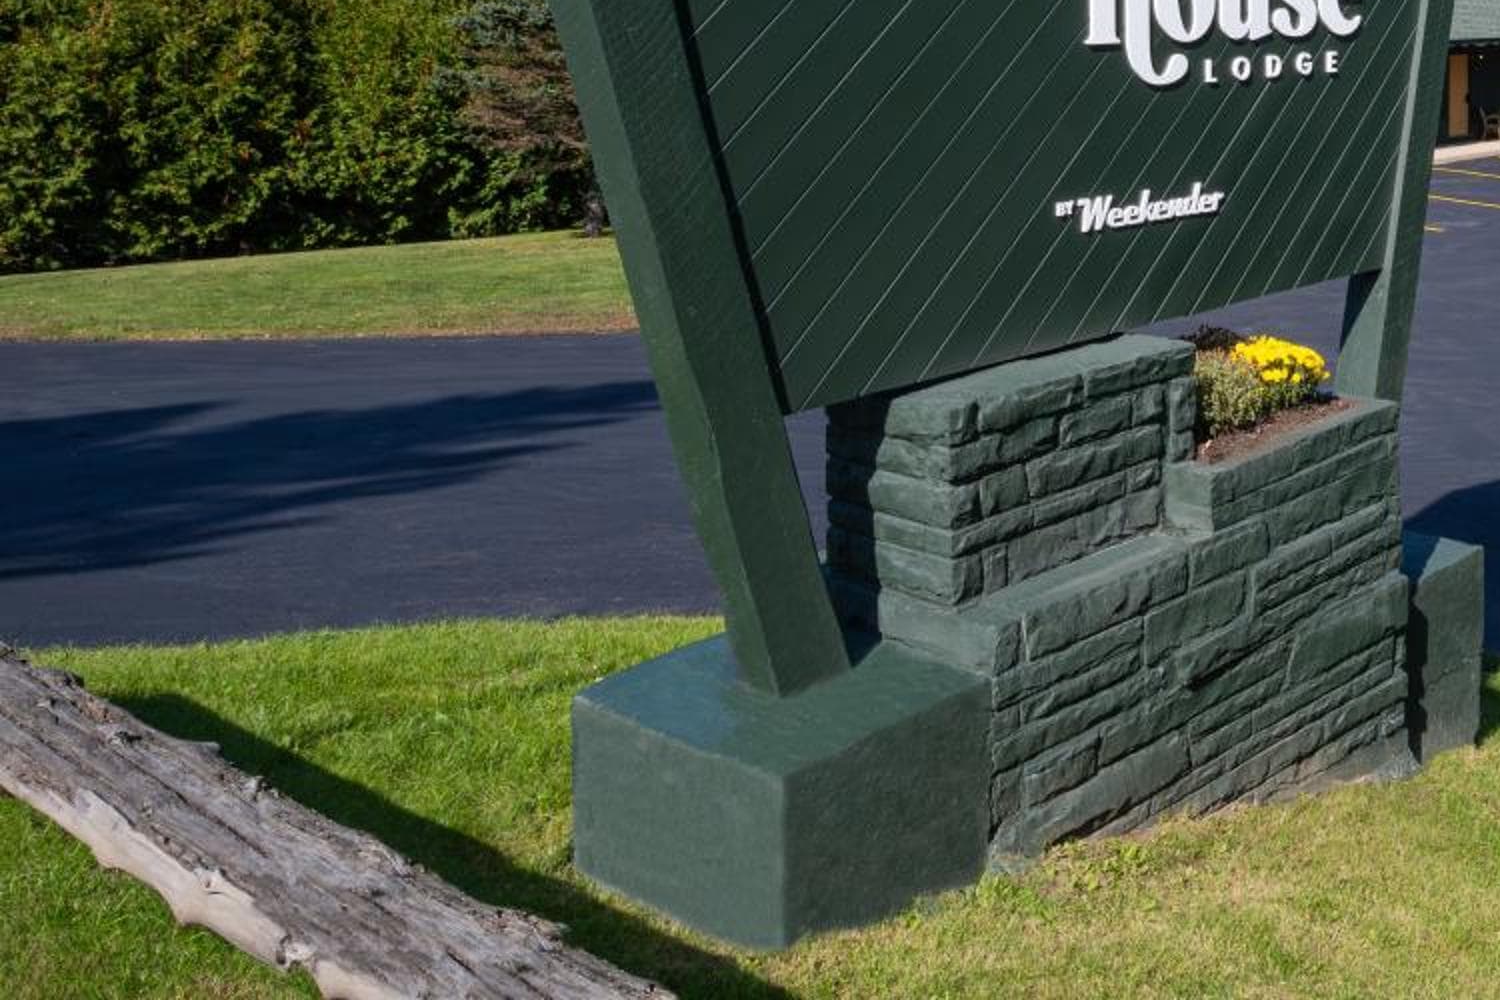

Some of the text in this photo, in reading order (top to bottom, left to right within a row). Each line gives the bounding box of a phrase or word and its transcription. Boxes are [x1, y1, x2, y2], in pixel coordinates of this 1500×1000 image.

[1203, 50, 1338, 83] LODGE
[1055, 181, 1225, 233] BY Weekender
